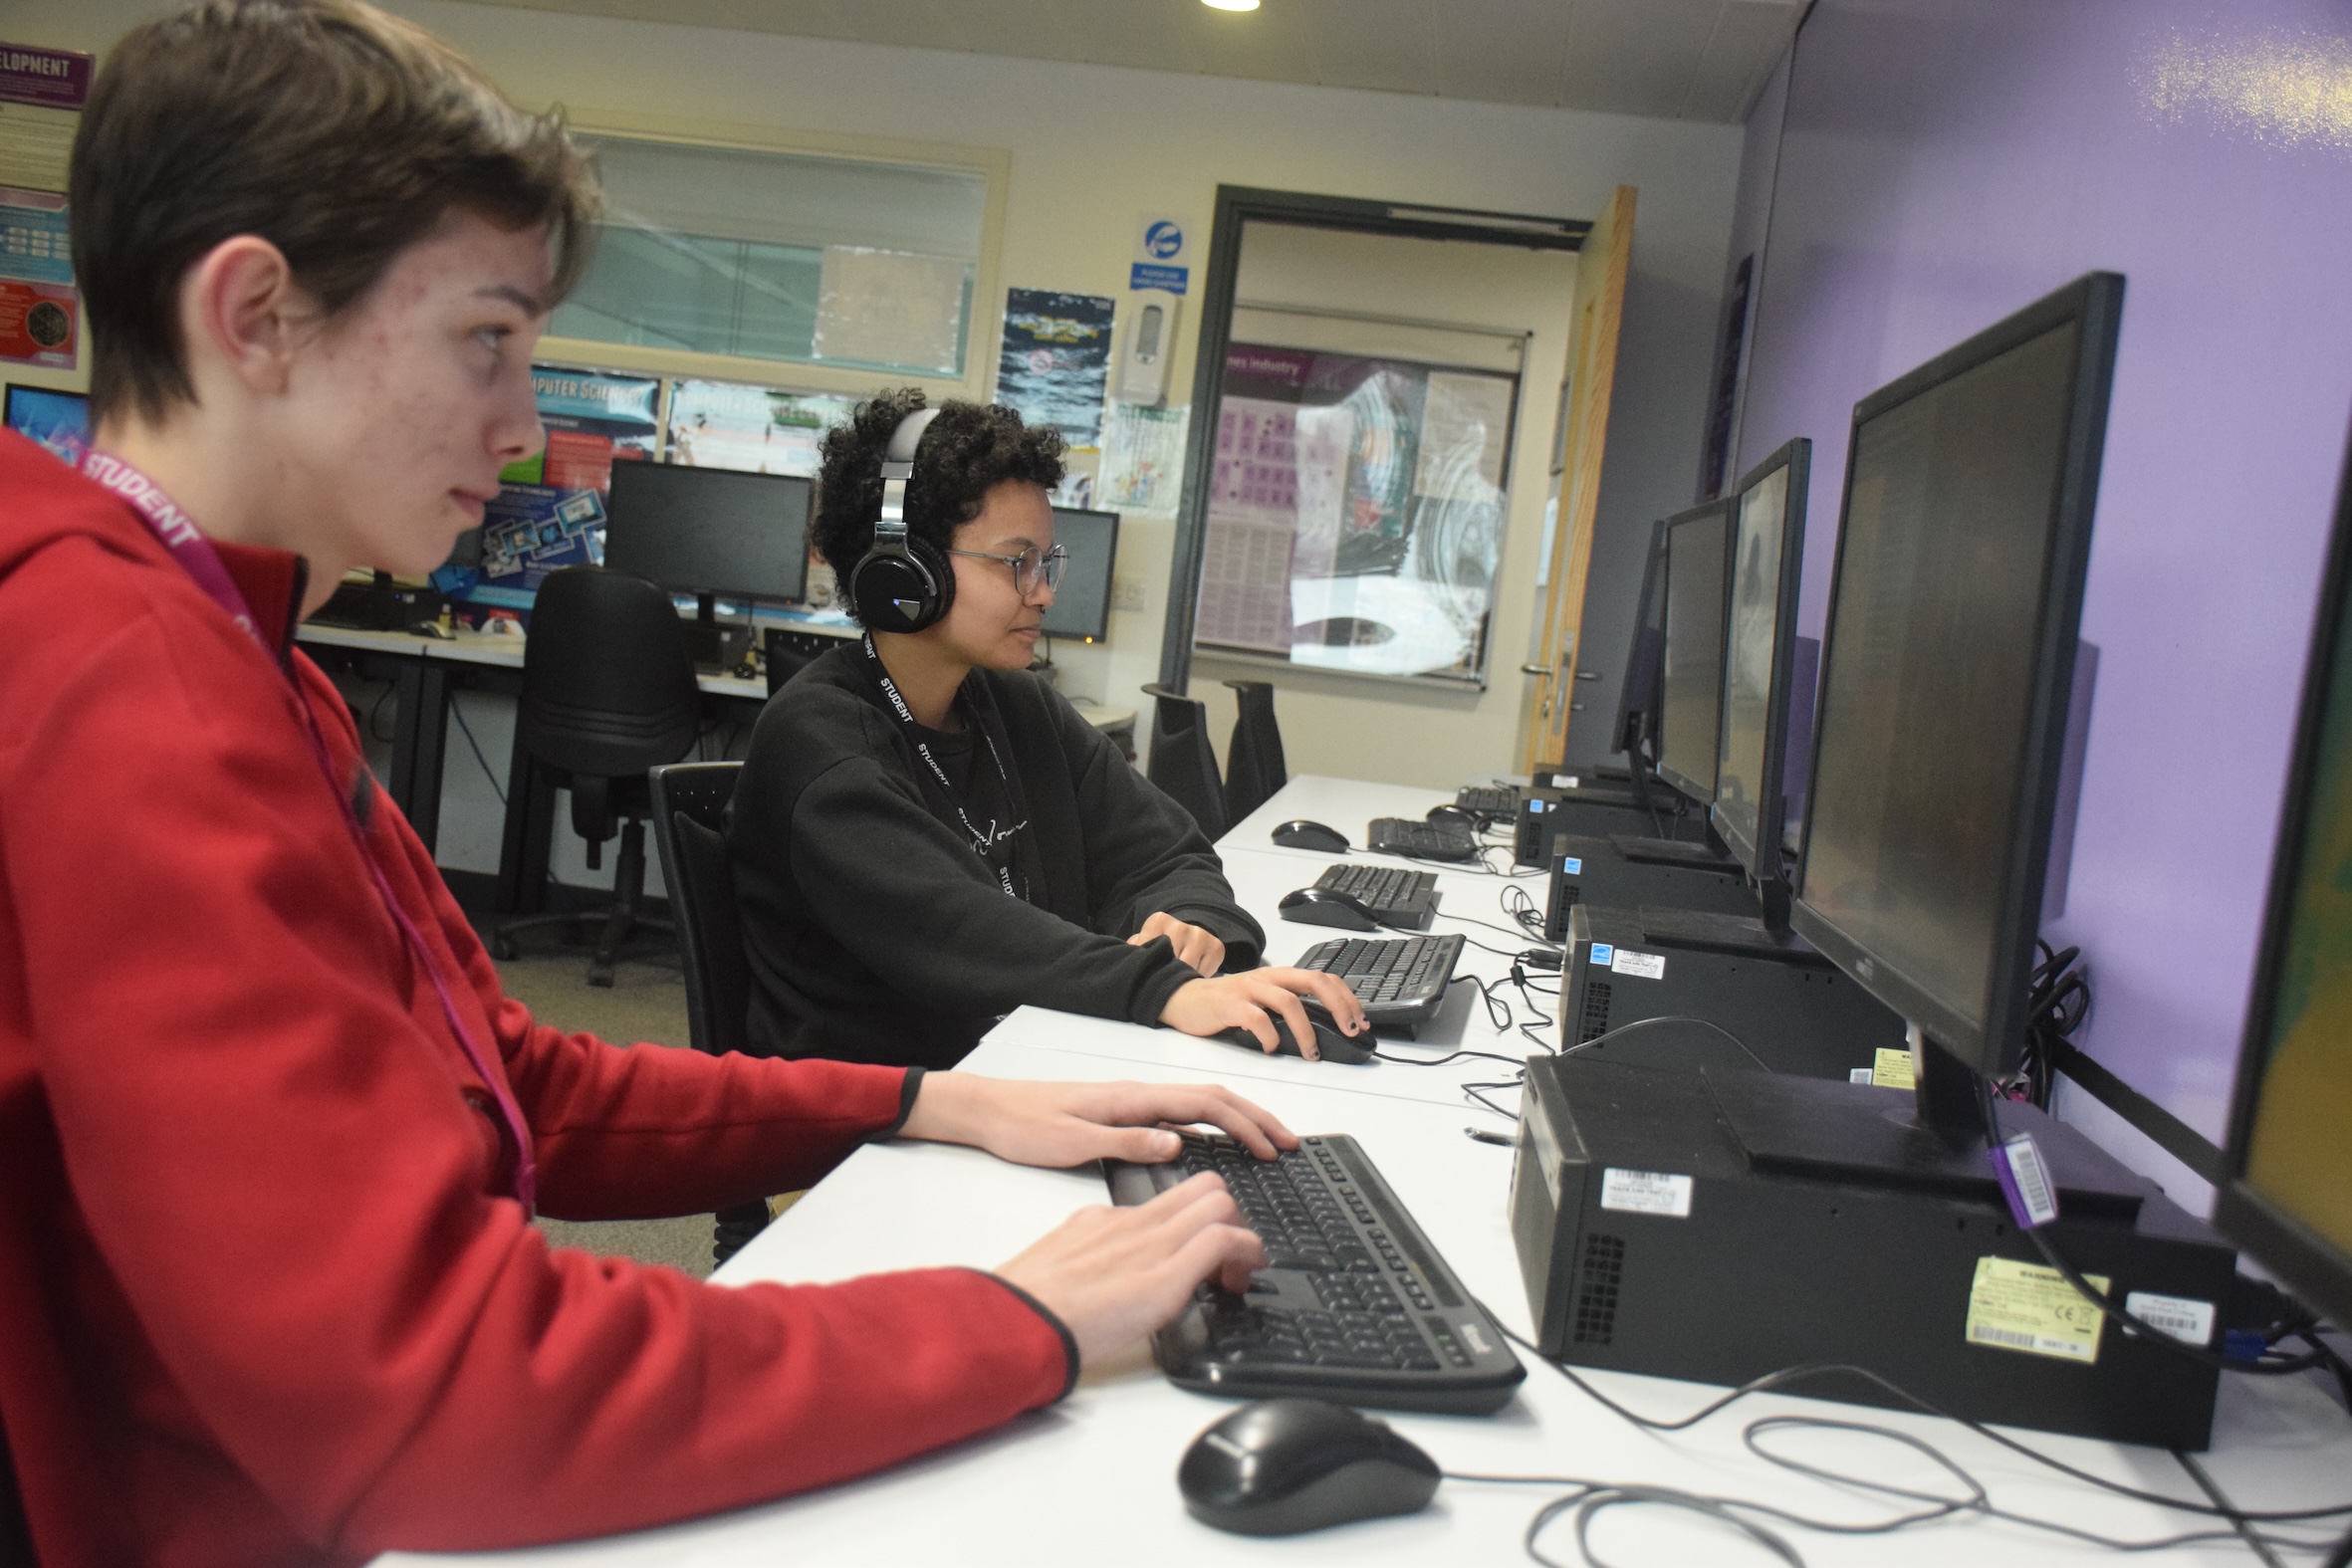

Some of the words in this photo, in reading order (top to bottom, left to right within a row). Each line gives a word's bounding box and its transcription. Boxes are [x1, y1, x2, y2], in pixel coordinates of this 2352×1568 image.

[0, 52, 70, 78] LOPMENT
[1250, 356, 1300, 376] industry
[83, 453, 199, 547] STUDENT
[880, 677, 914, 723] STUDENT
[918, 743, 951, 786] STUDENT
[958, 807, 992, 846] STUDENT
